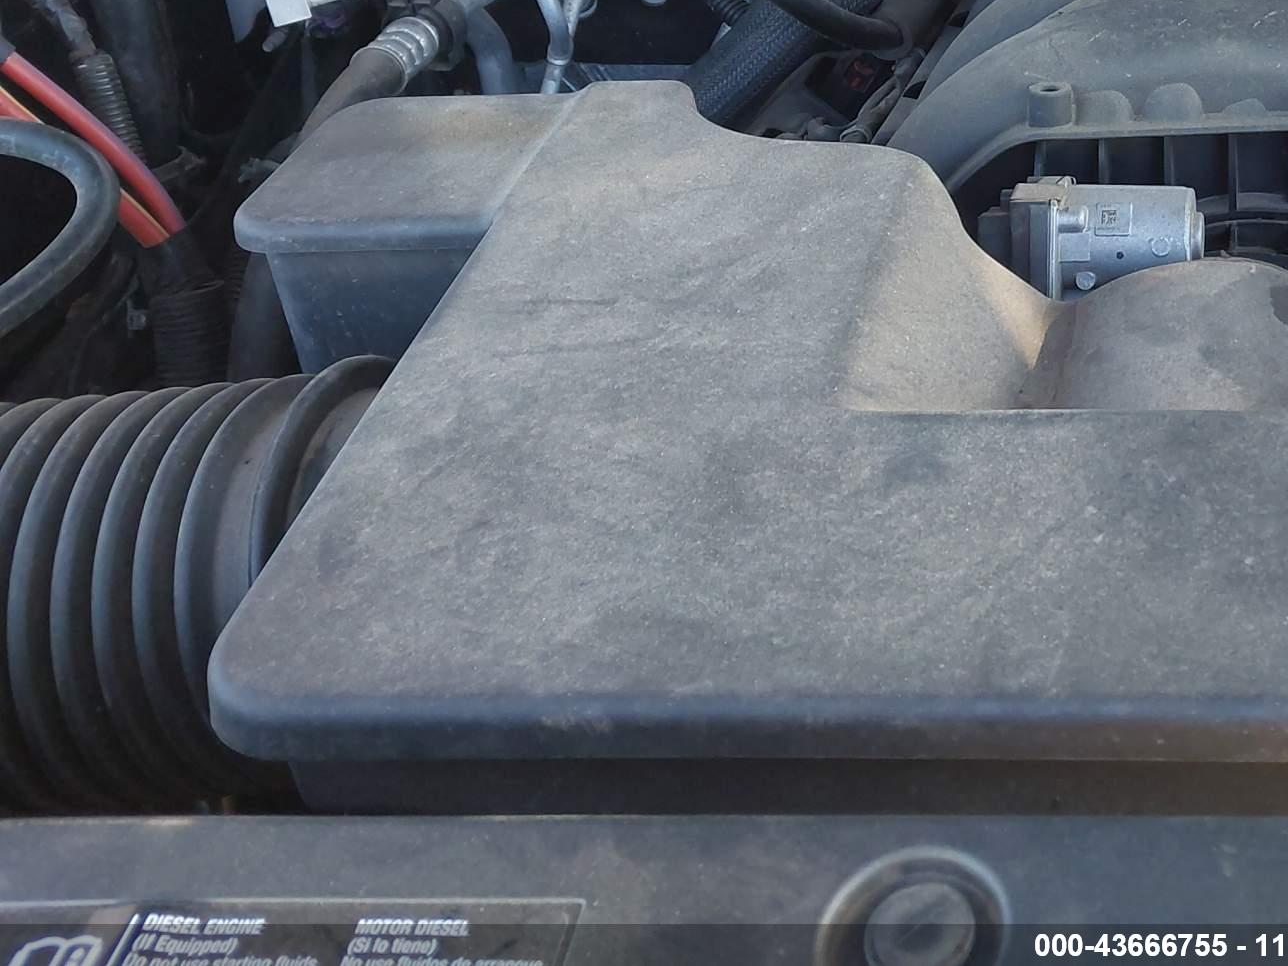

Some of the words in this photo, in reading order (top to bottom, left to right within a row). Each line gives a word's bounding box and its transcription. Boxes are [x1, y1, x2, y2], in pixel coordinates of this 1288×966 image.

[143, 914, 200, 934] DIESEL
[205, 918, 264, 935] ENGINE
[355, 918, 414, 935] MOTOR
[414, 919, 469, 936] DIESEL
[132, 933, 157, 952] (If
[156, 935, 238, 955] Equipped)
[347, 937, 372, 955] (Si
[372, 937, 390, 953] lo
[391, 937, 438, 956] tiene)
[122, 951, 148, 966] Do
[149, 956, 178, 966] not
[180, 958, 209, 966] use
[340, 955, 363, 966] No
